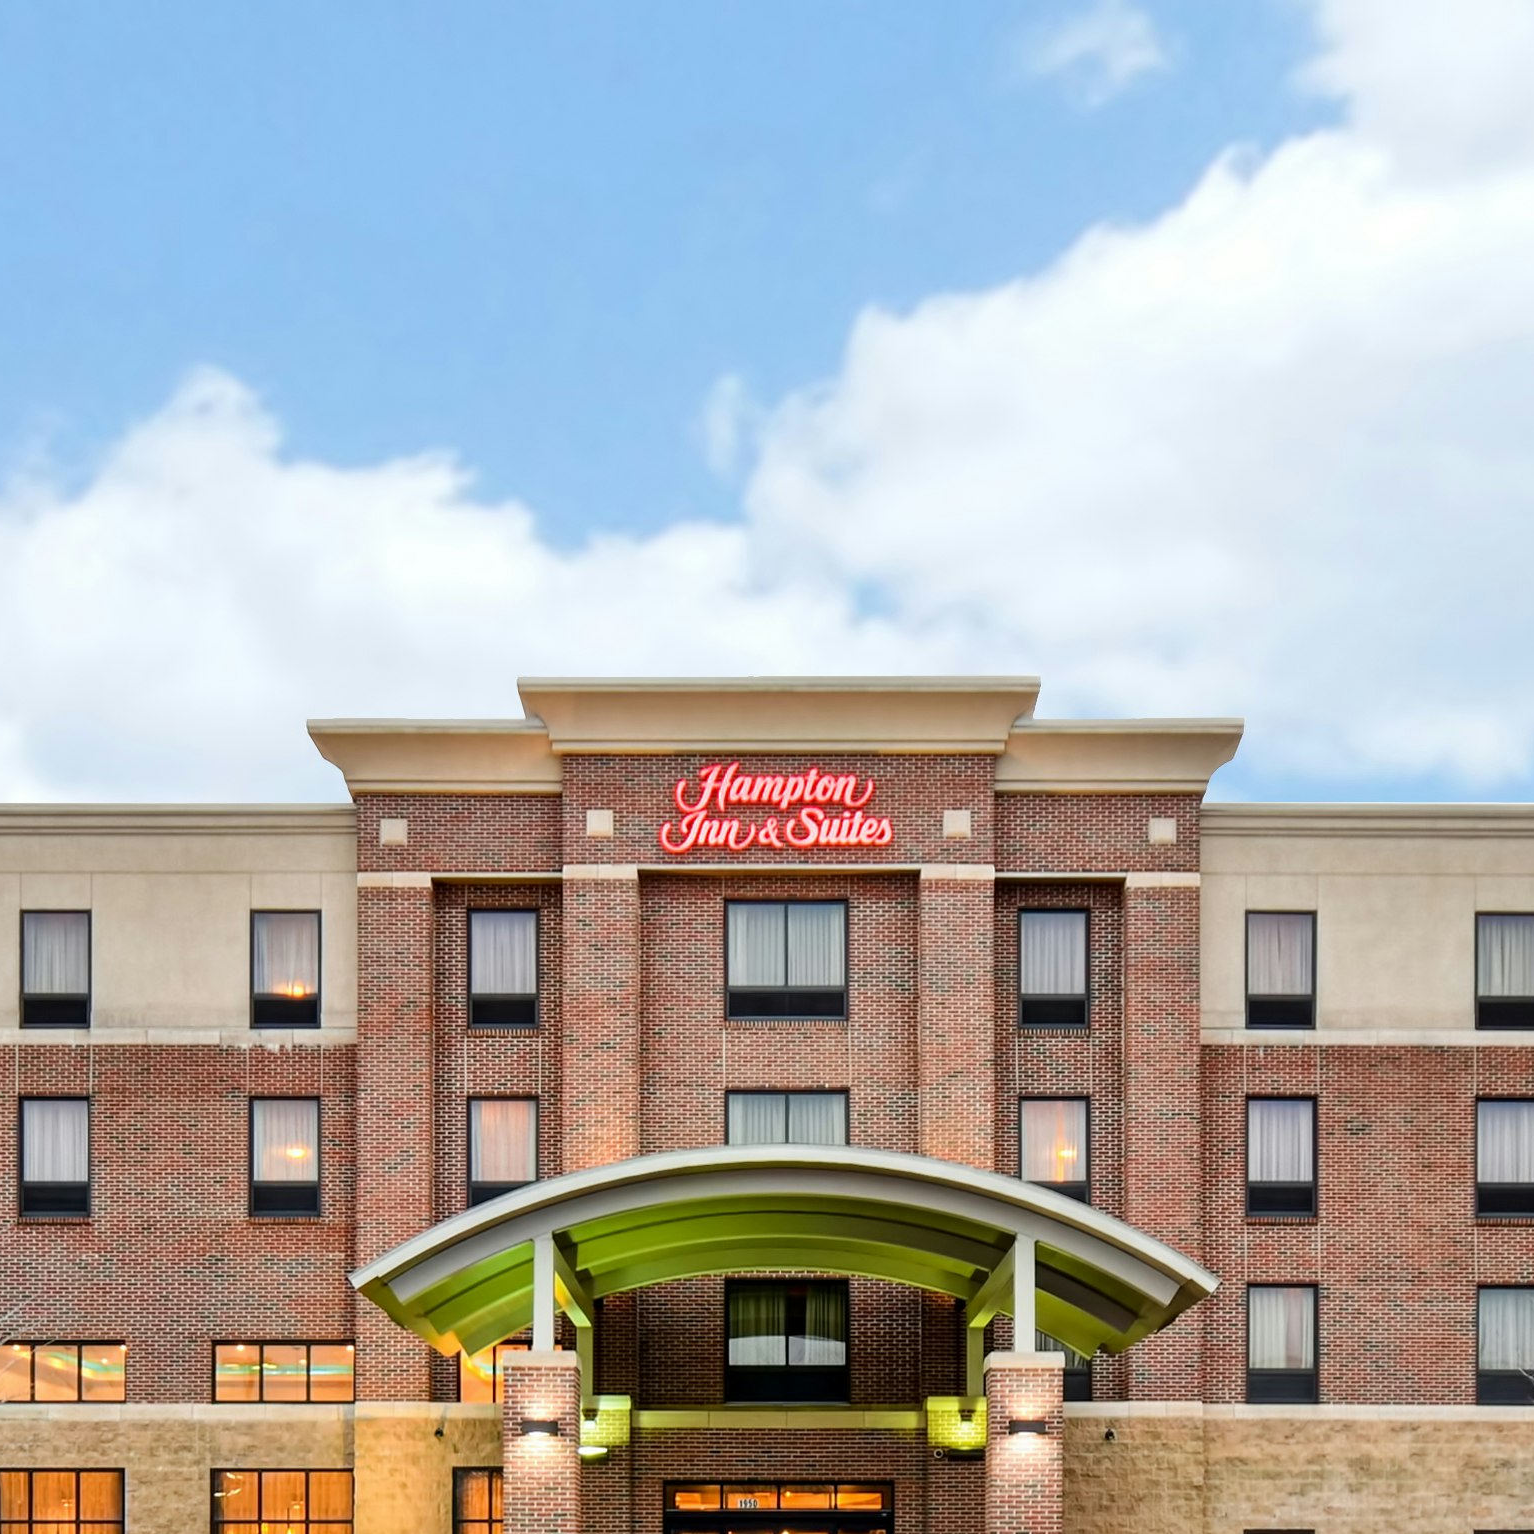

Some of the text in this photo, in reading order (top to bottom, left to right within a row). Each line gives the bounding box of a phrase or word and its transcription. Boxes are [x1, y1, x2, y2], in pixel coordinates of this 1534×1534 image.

[675, 761, 874, 813] Hampton
[659, 806, 894, 854] Inn & Suites
[739, 1499, 758, 1509] 1950
